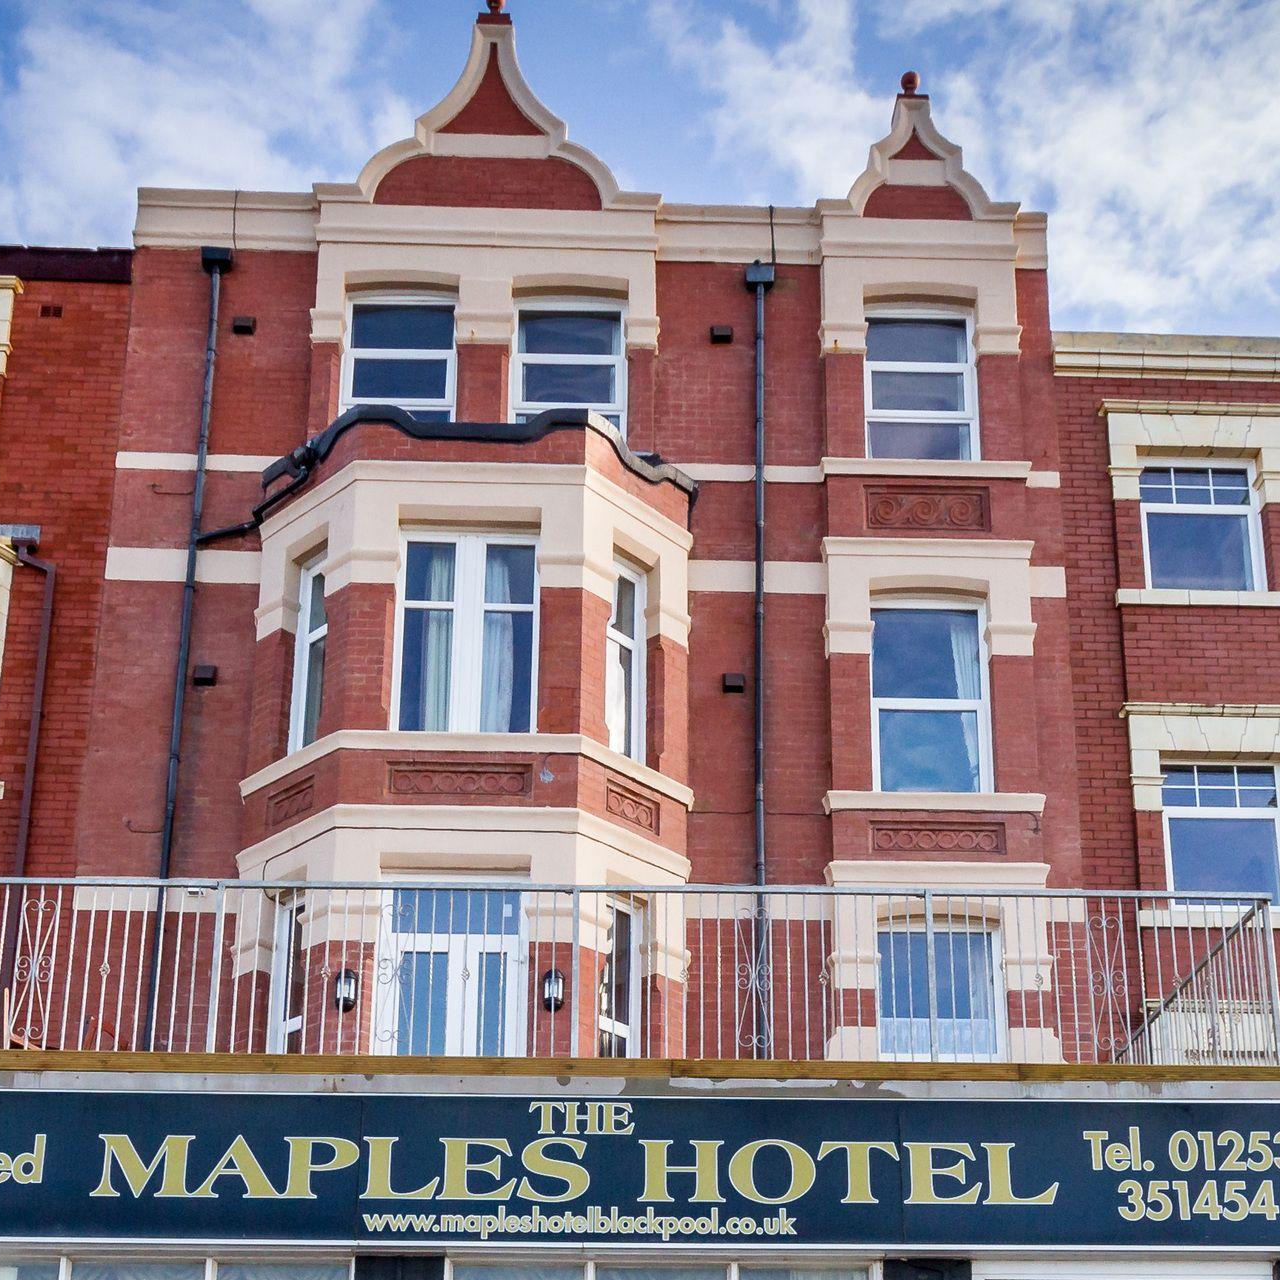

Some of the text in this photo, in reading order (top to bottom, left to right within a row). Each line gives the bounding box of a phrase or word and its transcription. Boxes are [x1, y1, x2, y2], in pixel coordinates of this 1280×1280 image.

[528, 1101, 636, 1136] THE
[89, 1134, 1060, 1205] MAPLES HOTEL
[1083, 1126, 1156, 1172] Tel.
[1117, 1179, 1280, 1222] 351454
[362, 1205, 798, 1241] www.mapleshotelblackpool.co.uk
